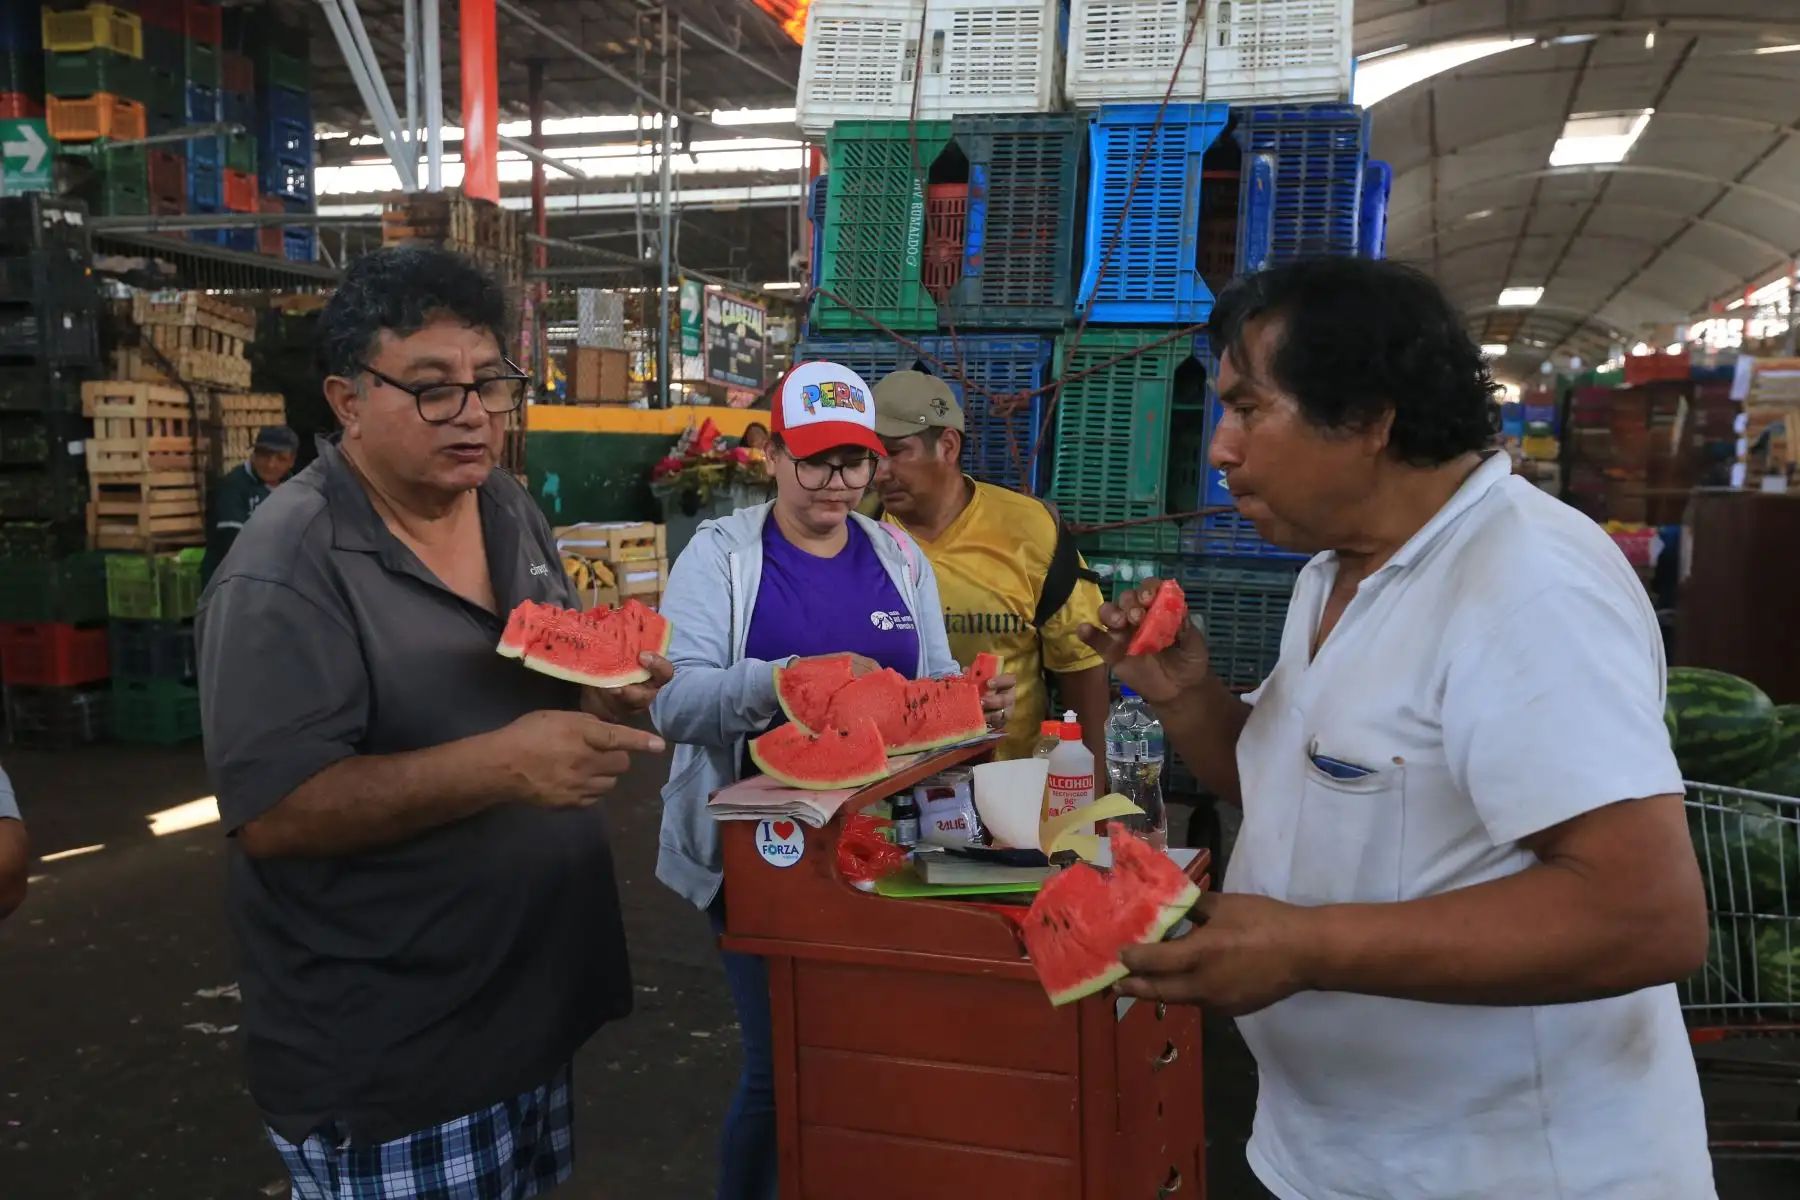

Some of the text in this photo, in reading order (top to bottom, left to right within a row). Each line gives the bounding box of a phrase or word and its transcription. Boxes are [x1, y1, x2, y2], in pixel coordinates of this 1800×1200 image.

[801, 381, 866, 415] PERU
[762, 821, 773, 842] I
[762, 844, 800, 855] FORZA
